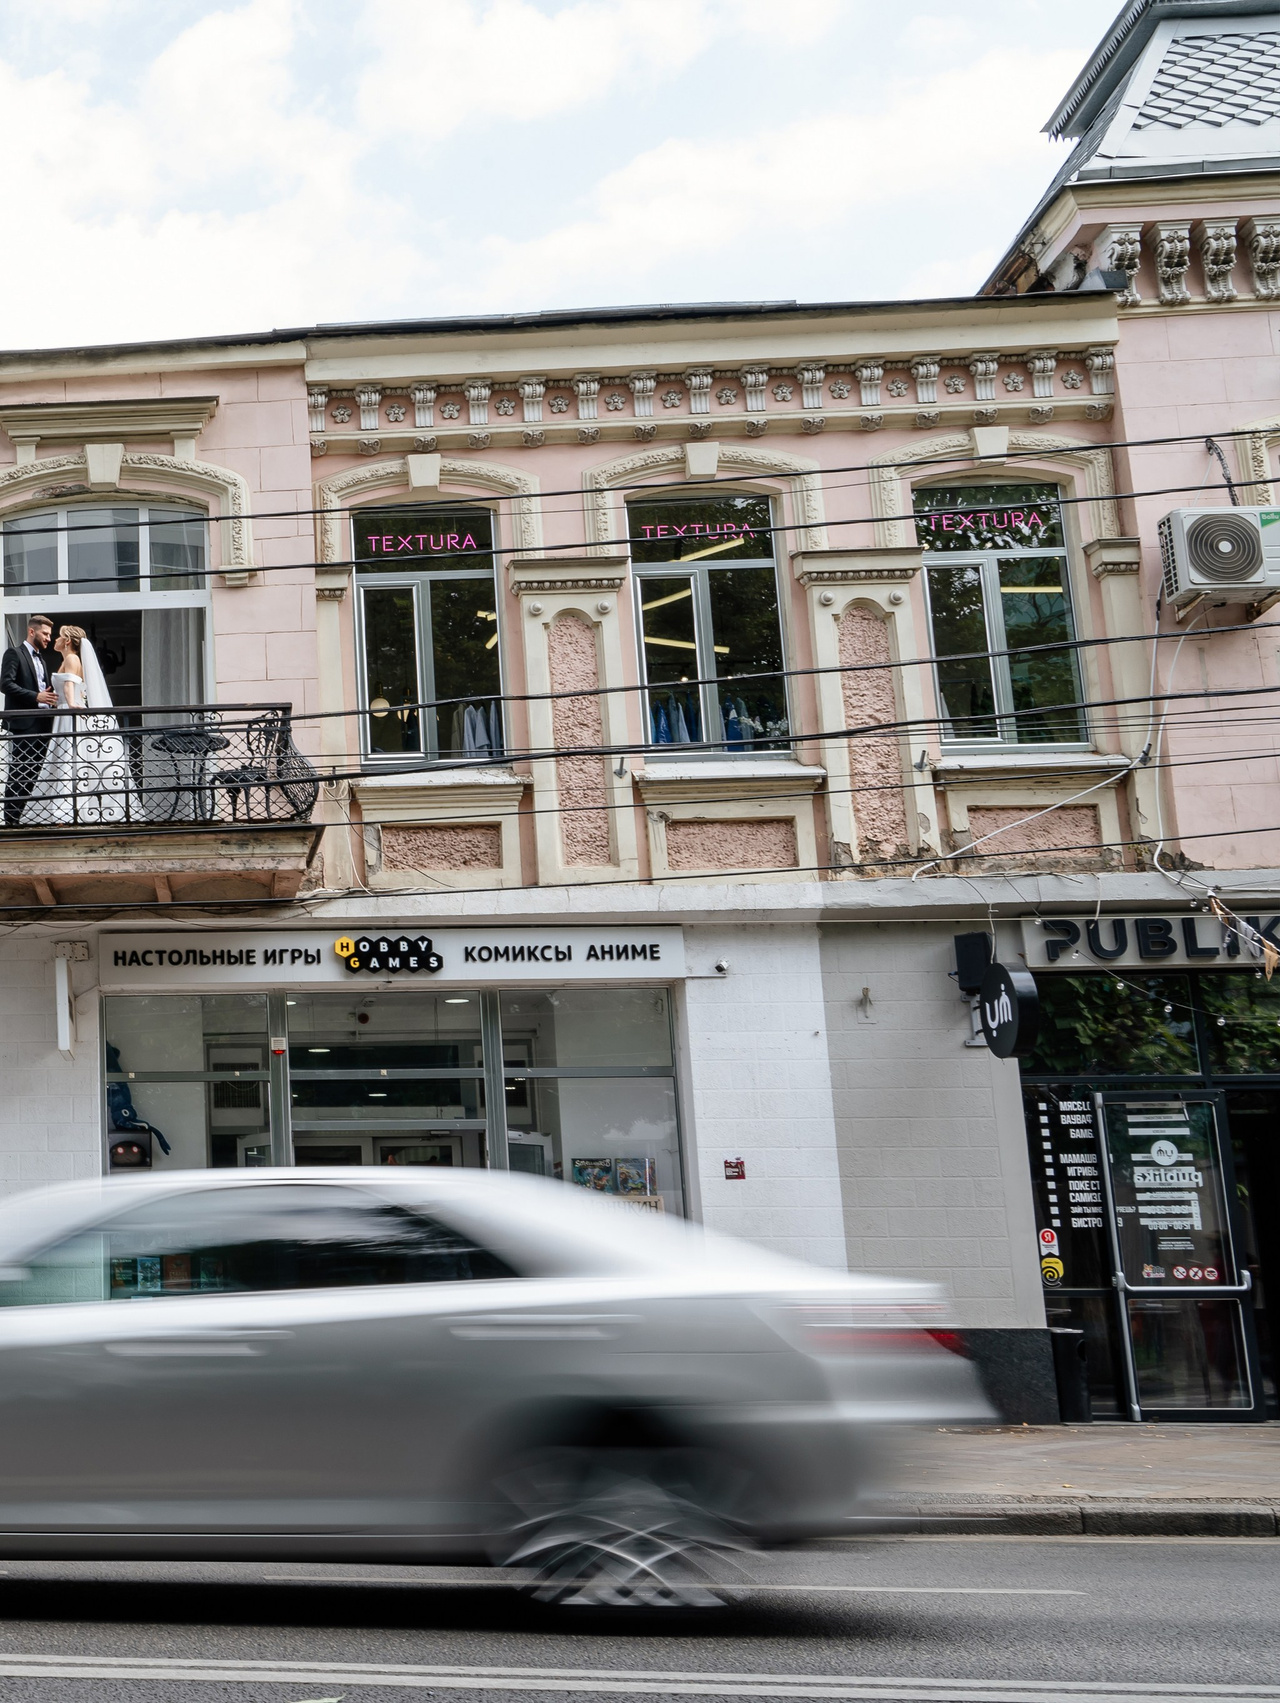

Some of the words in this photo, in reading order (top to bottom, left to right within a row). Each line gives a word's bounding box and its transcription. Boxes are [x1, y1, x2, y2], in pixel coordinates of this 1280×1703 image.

[929, 511, 1044, 532] TEXTURA
[641, 523, 756, 540] TEXTURA
[367, 533, 477, 552] TEXTURA
[340, 940, 428, 952] HOBBY
[464, 945, 572, 962] КОМИКСЫ
[586, 944, 661, 961] АНИМЕ
[113, 949, 256, 967] НАСТОЛЬНЫЕ
[264, 948, 321, 965] ИГРЫ
[350, 956, 438, 968] GAMES
[1071, 1218, 1102, 1227] БИСТРО
